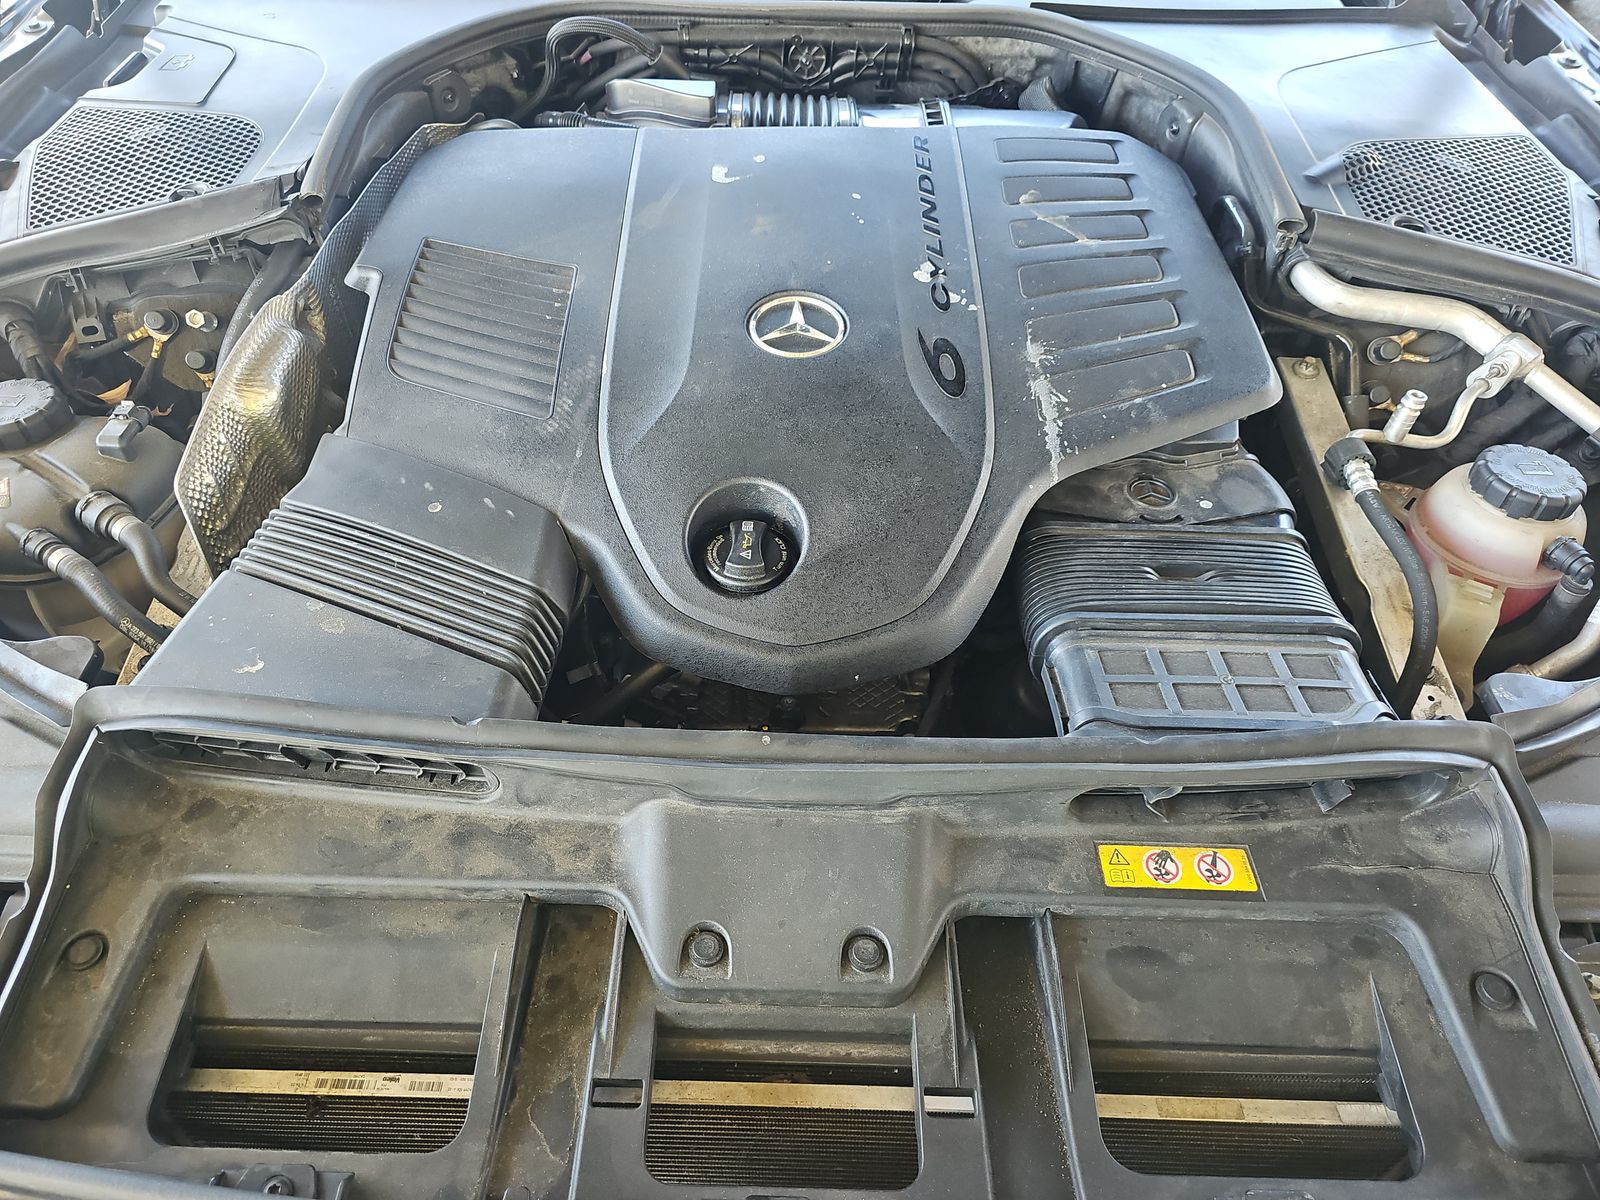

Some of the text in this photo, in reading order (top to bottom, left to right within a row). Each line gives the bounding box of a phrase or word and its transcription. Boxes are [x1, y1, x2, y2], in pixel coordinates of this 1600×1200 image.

[912, 134, 967, 399] 6 CYLINDER
[772, 561, 784, 572] Turn
[382, 1074, 401, 1084] Valeo
